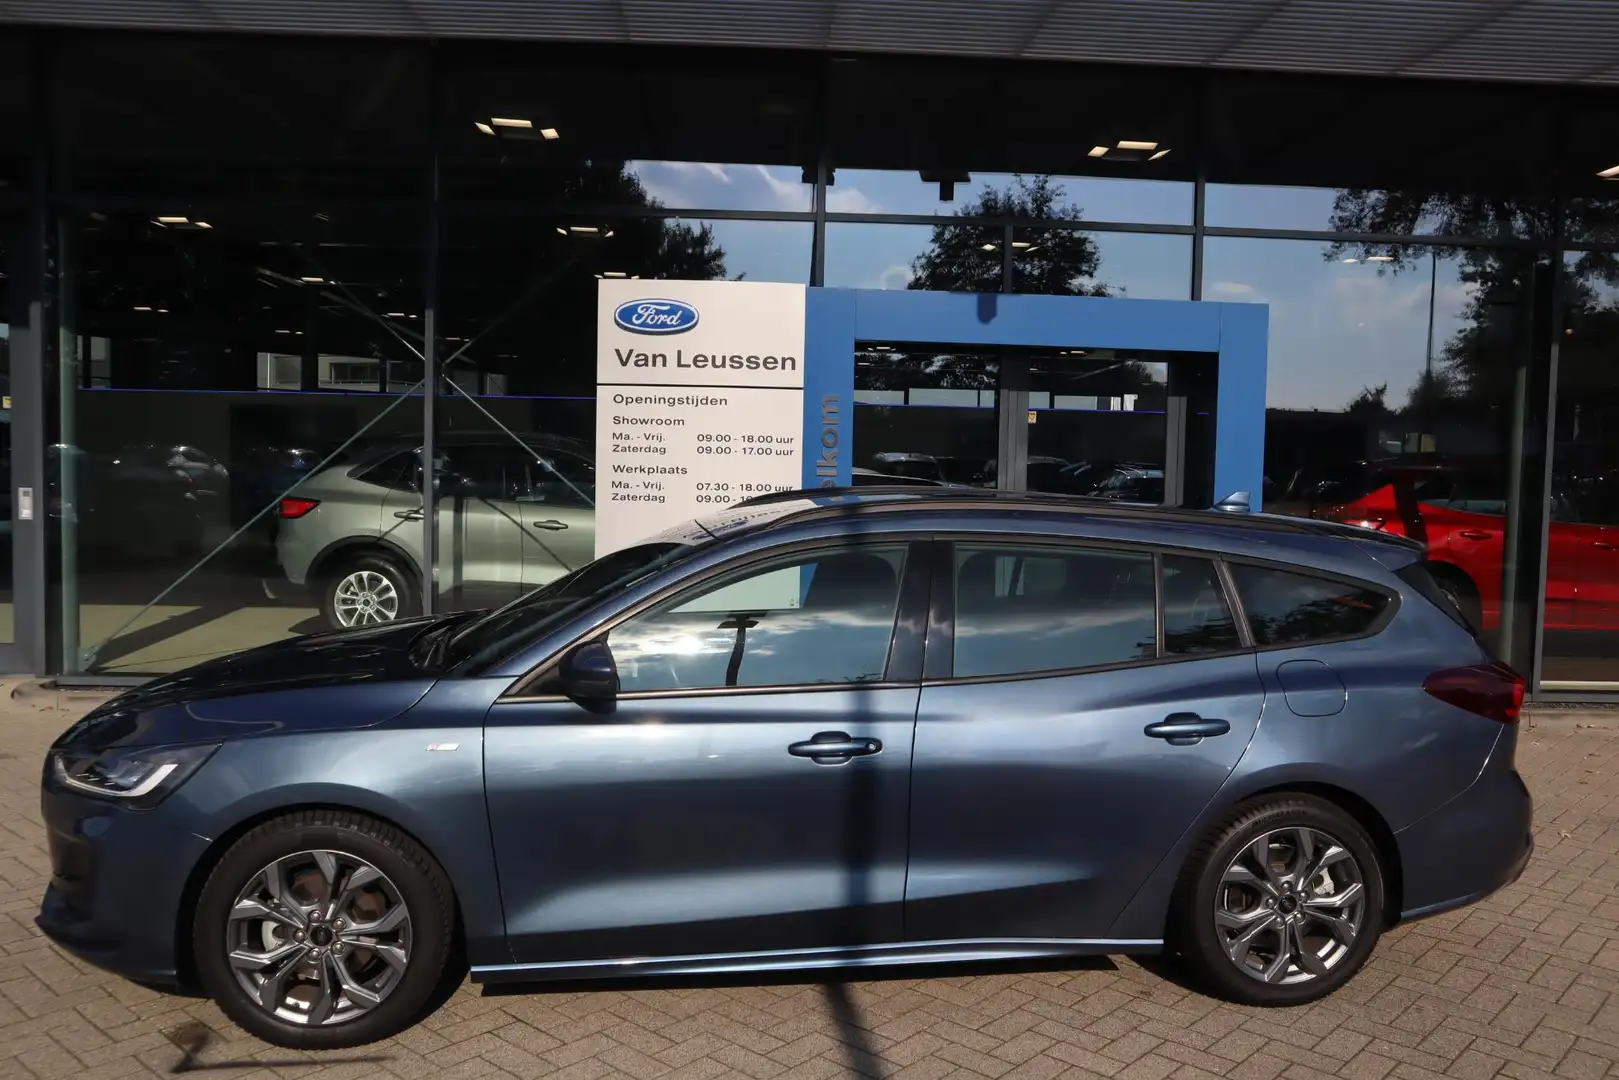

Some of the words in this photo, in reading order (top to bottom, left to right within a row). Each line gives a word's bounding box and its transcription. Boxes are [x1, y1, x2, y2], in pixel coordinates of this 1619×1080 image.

[632, 303, 683, 325] Ford
[614, 348, 667, 368] Van
[676, 349, 796, 371] Leussen
[613, 393, 728, 407] Openingstijden
[612, 415, 685, 426] Showroom
[612, 432, 634, 441] Ma.
[643, 432, 666, 443] Vrij.
[697, 433, 732, 443] 09.00
[741, 434, 773, 443] 18.00
[612, 444, 667, 456] Zaterdag
[696, 445, 732, 455] 09.00
[742, 447, 773, 456] 17.00
[612, 464, 688, 476] Werkplaats
[611, 480, 633, 489] Ma.
[643, 481, 666, 492] Vrij.
[696, 482, 729, 491] 07.30
[739, 483, 772, 492] 18.00
[611, 492, 666, 504] Zaterdag
[696, 494, 731, 504] 09.00
